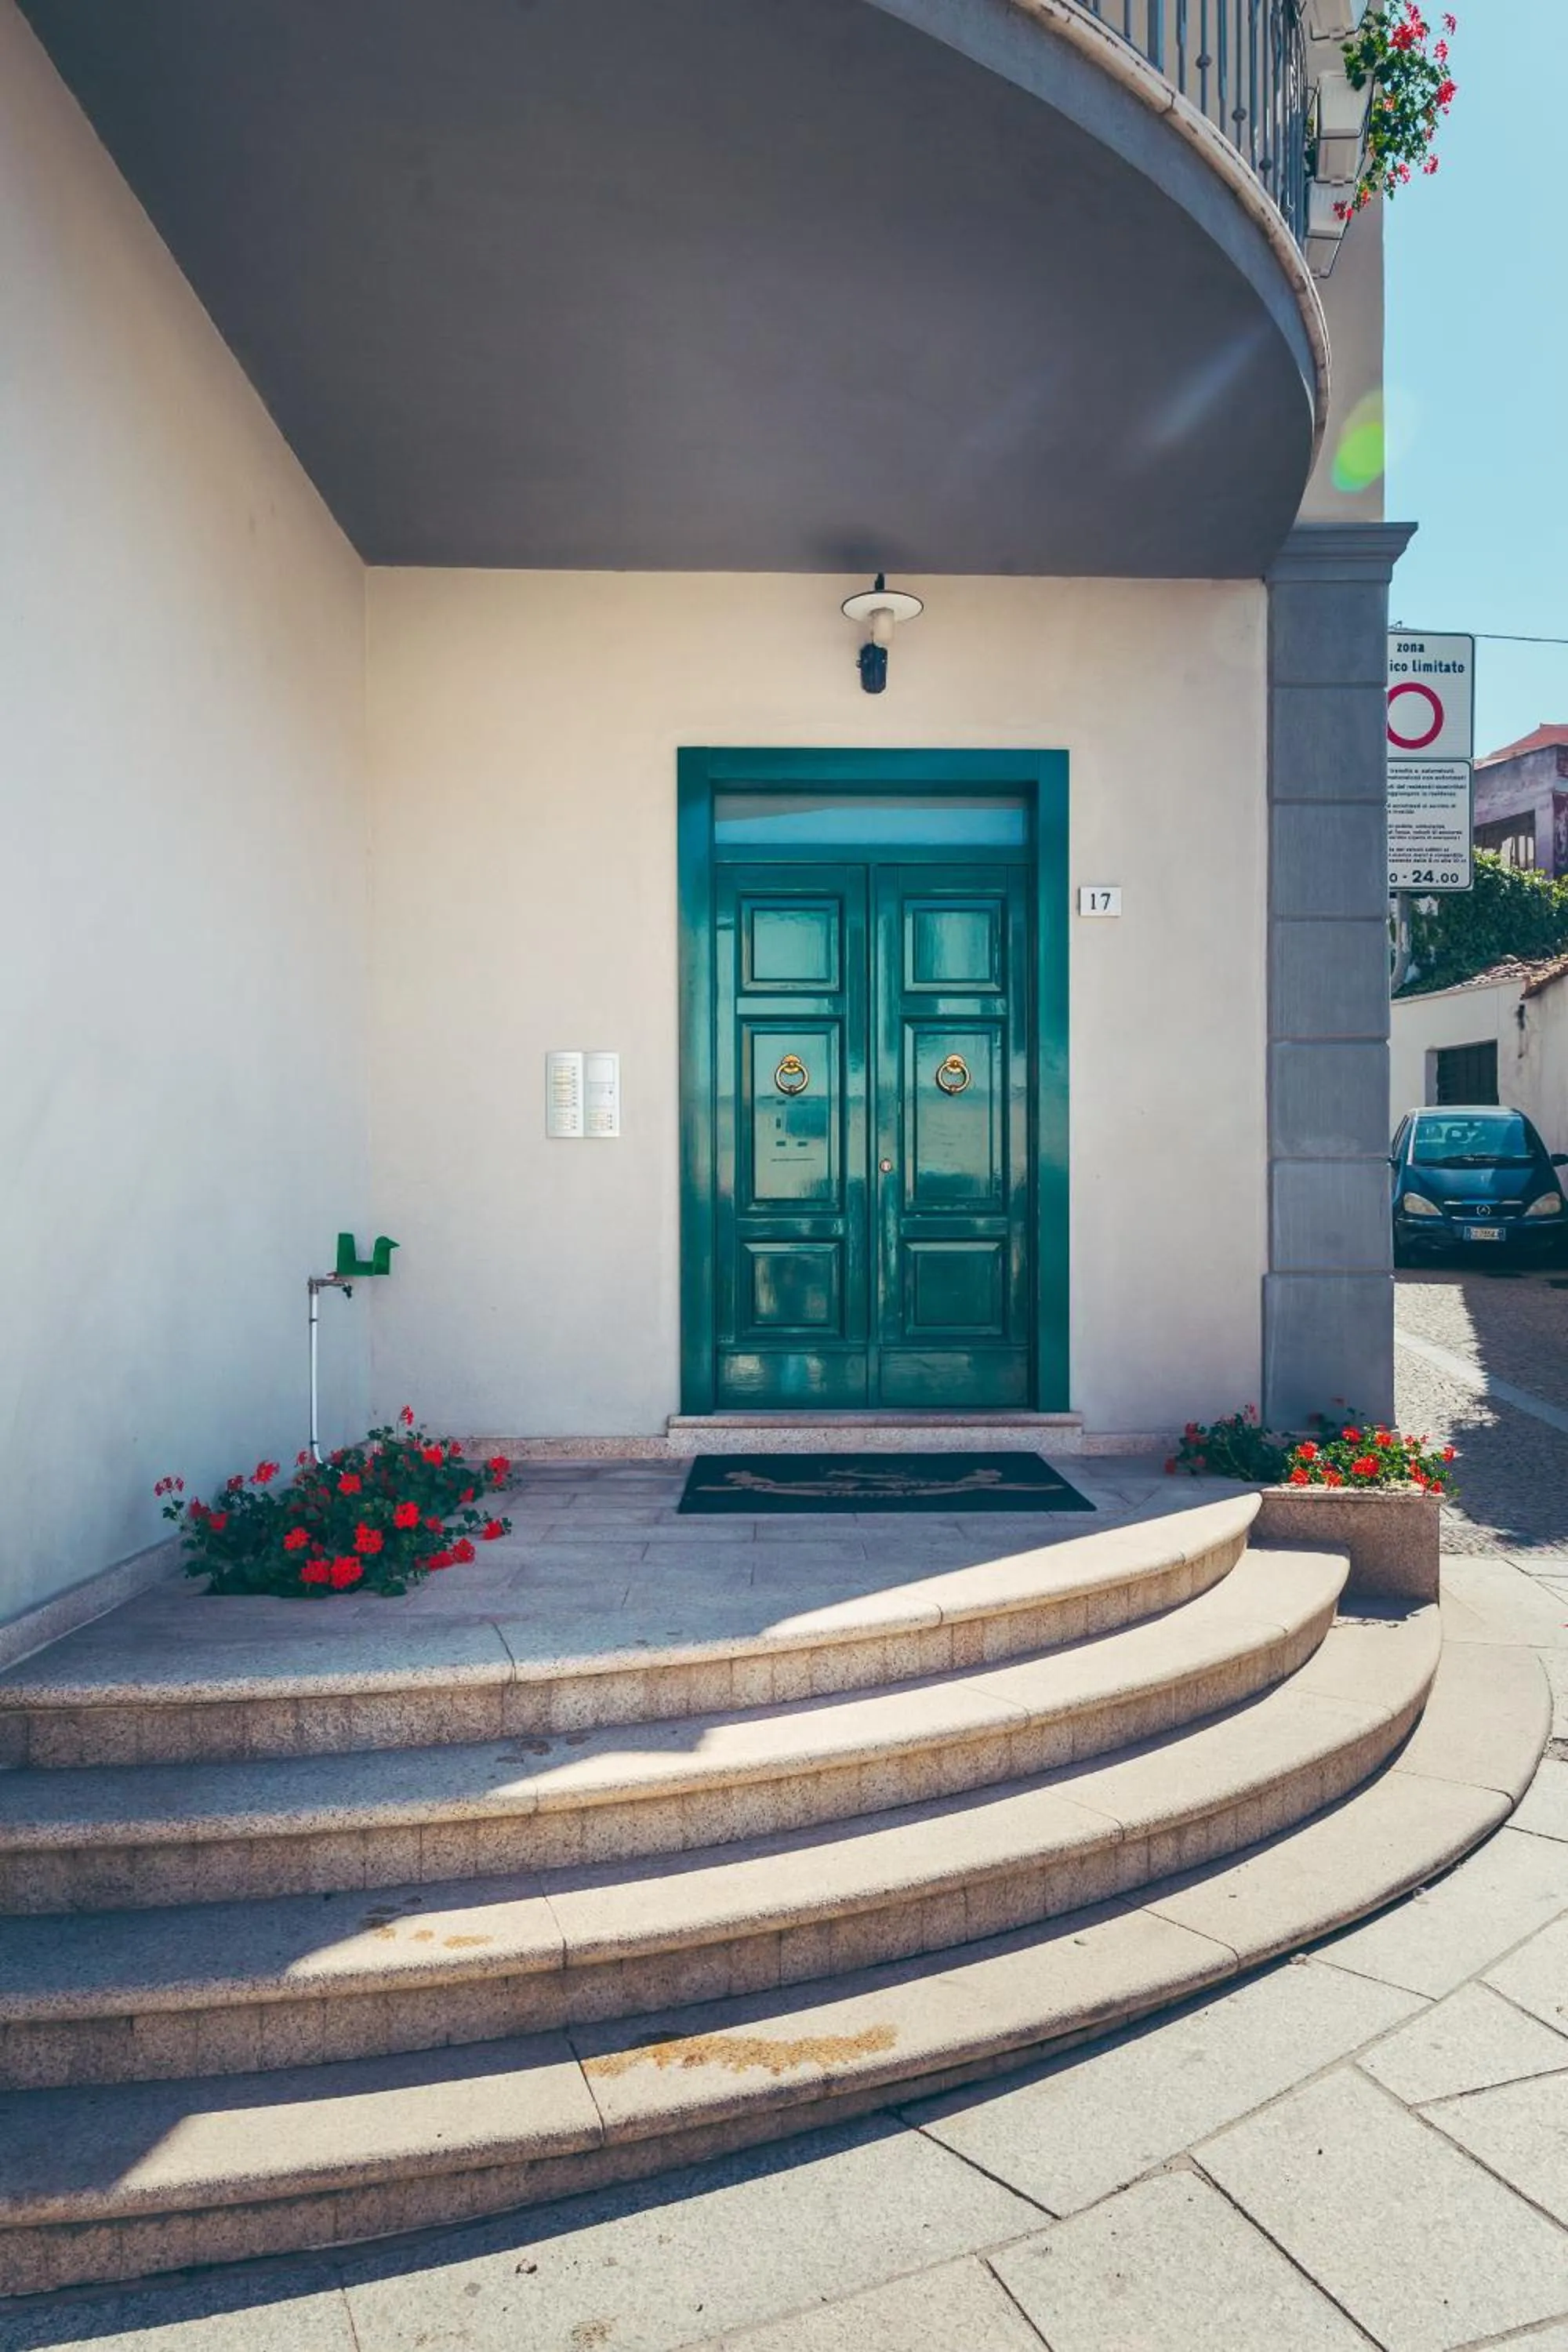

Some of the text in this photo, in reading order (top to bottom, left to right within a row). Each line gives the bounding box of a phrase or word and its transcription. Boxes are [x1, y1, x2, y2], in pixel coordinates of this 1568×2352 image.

[1397, 643, 1425, 652] zona
[1412, 659, 1465, 673] limitato
[1412, 869, 1459, 884] 24.00
[1091, 892, 1111, 910] 17
